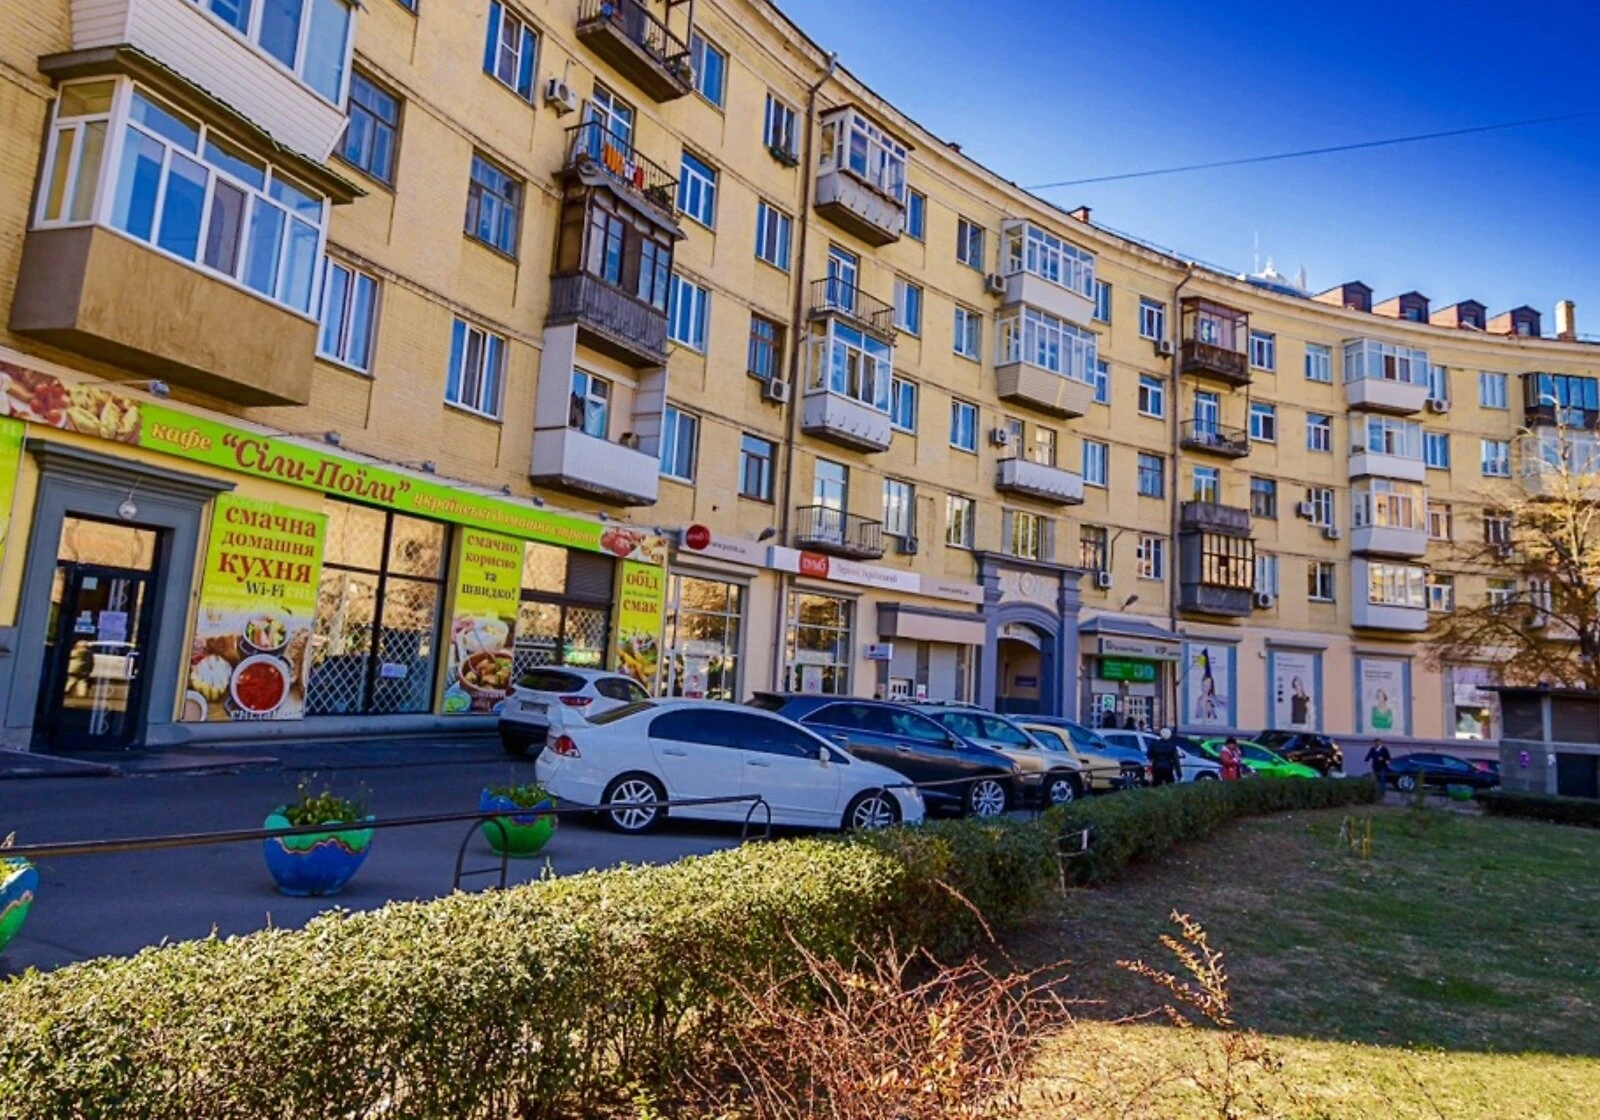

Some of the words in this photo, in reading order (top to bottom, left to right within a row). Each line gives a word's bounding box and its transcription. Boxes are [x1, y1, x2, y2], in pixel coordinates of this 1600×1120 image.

[151, 423, 212, 452] кафе
[222, 432, 411, 502] “Сіли-Поїли”
[225, 506, 316, 538] смачна
[221, 531, 315, 557] домашня
[218, 552, 311, 583] кухня
[485, 572, 497, 582] та
[246, 581, 285, 597] Wi-Fi
[462, 583, 516, 601] швидко!
[623, 599, 657, 614] смак
